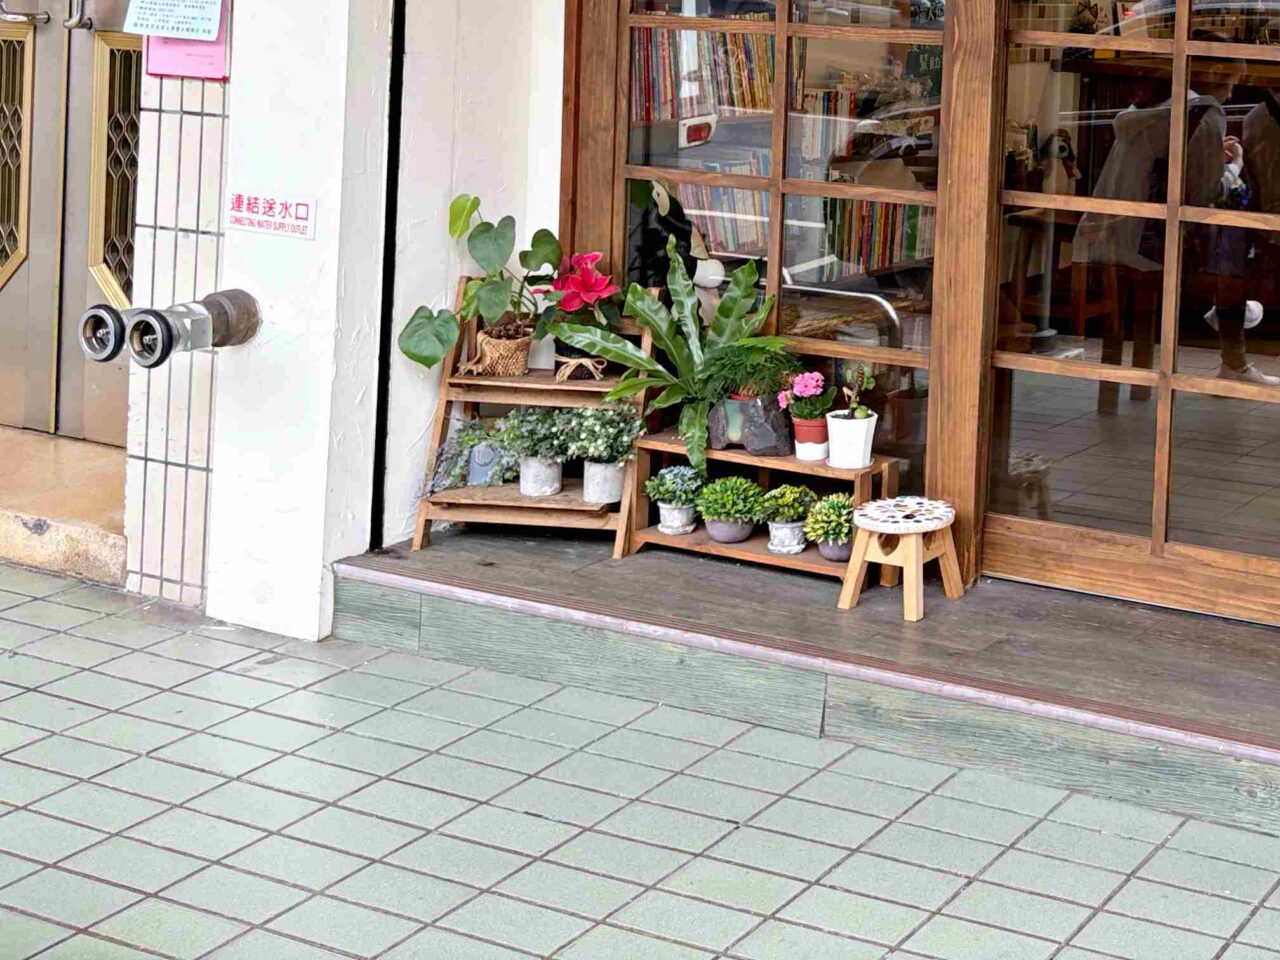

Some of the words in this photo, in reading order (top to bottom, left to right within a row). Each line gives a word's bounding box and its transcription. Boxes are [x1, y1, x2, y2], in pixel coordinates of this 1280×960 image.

[230, 193, 309, 222] 連結送水口
[258, 220, 272, 230] WATER
